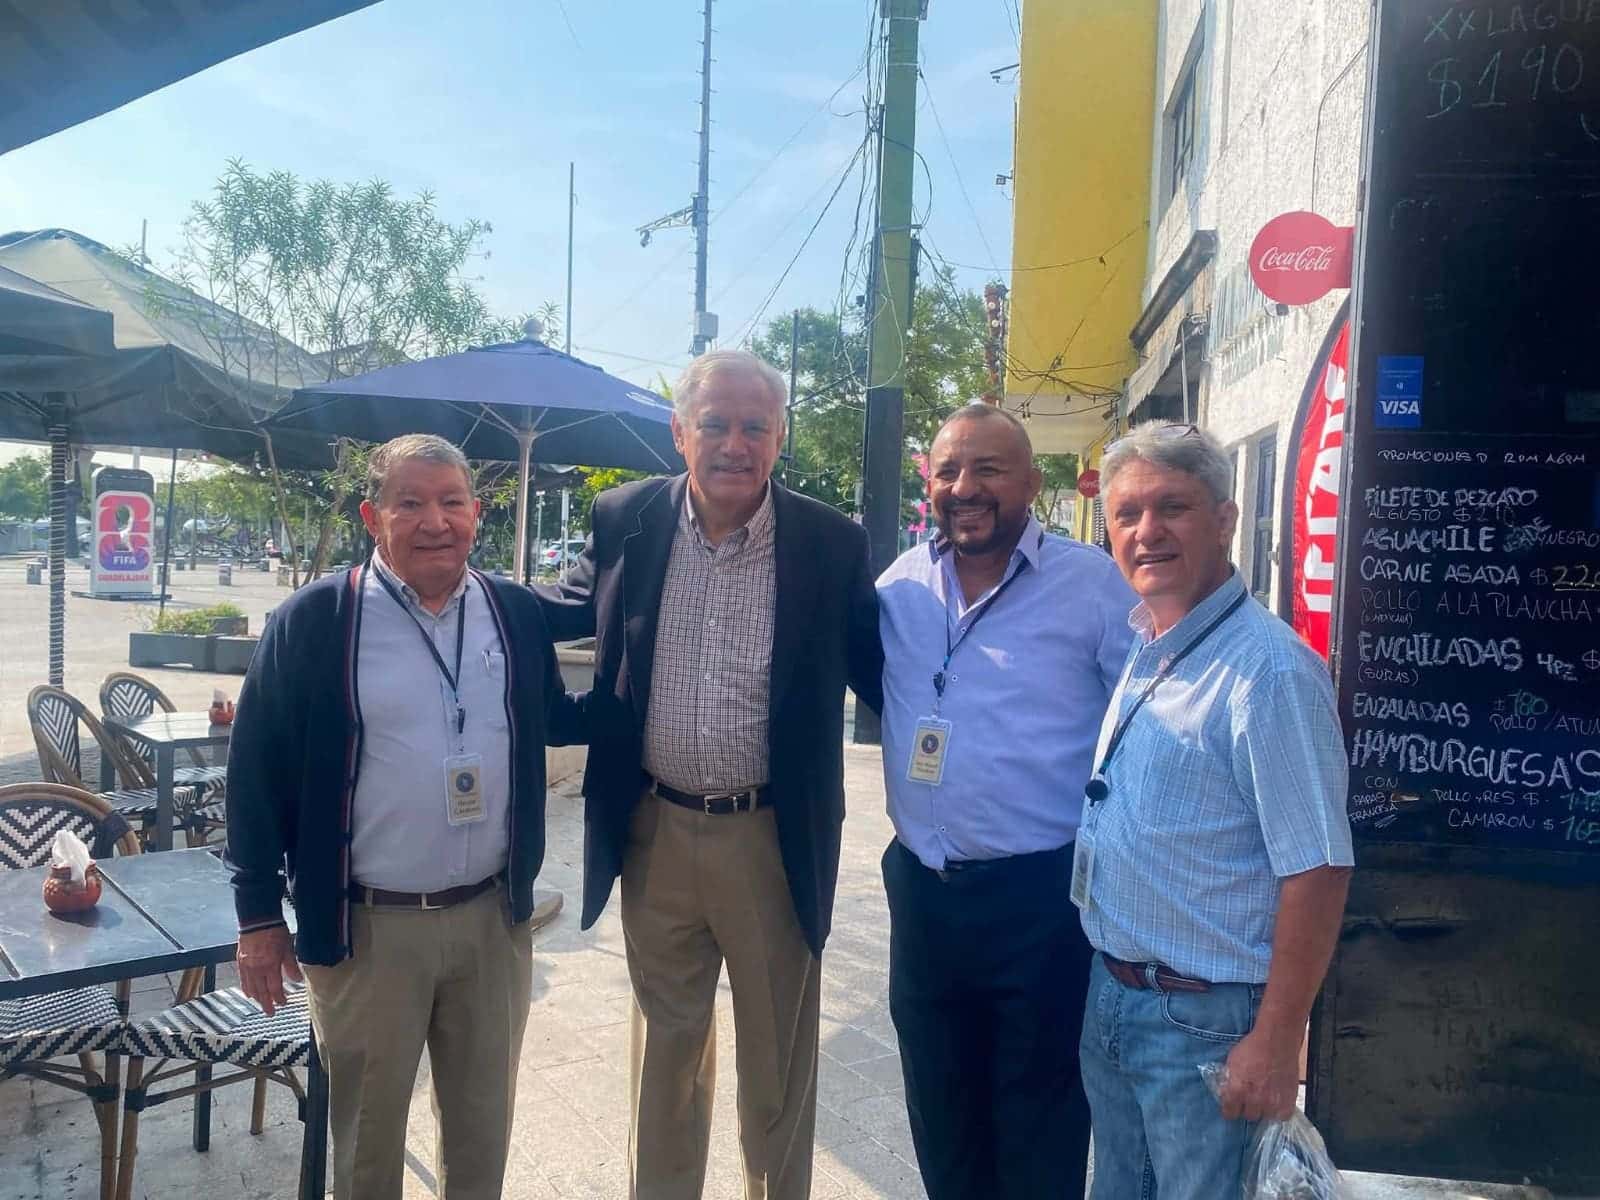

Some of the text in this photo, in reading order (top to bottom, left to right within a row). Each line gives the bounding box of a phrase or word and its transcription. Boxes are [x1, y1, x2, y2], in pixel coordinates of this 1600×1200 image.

[1379, 400, 1420, 415] VISA
[1361, 524, 1497, 552] AGUACHILE
[112, 555, 137, 566] FIFA
[1360, 555, 1433, 583] CARNE
[1444, 565, 1521, 585] ASADA
[1487, 592, 1593, 623] PLANCHA
[1358, 631, 1524, 671] ENCHILADAS
